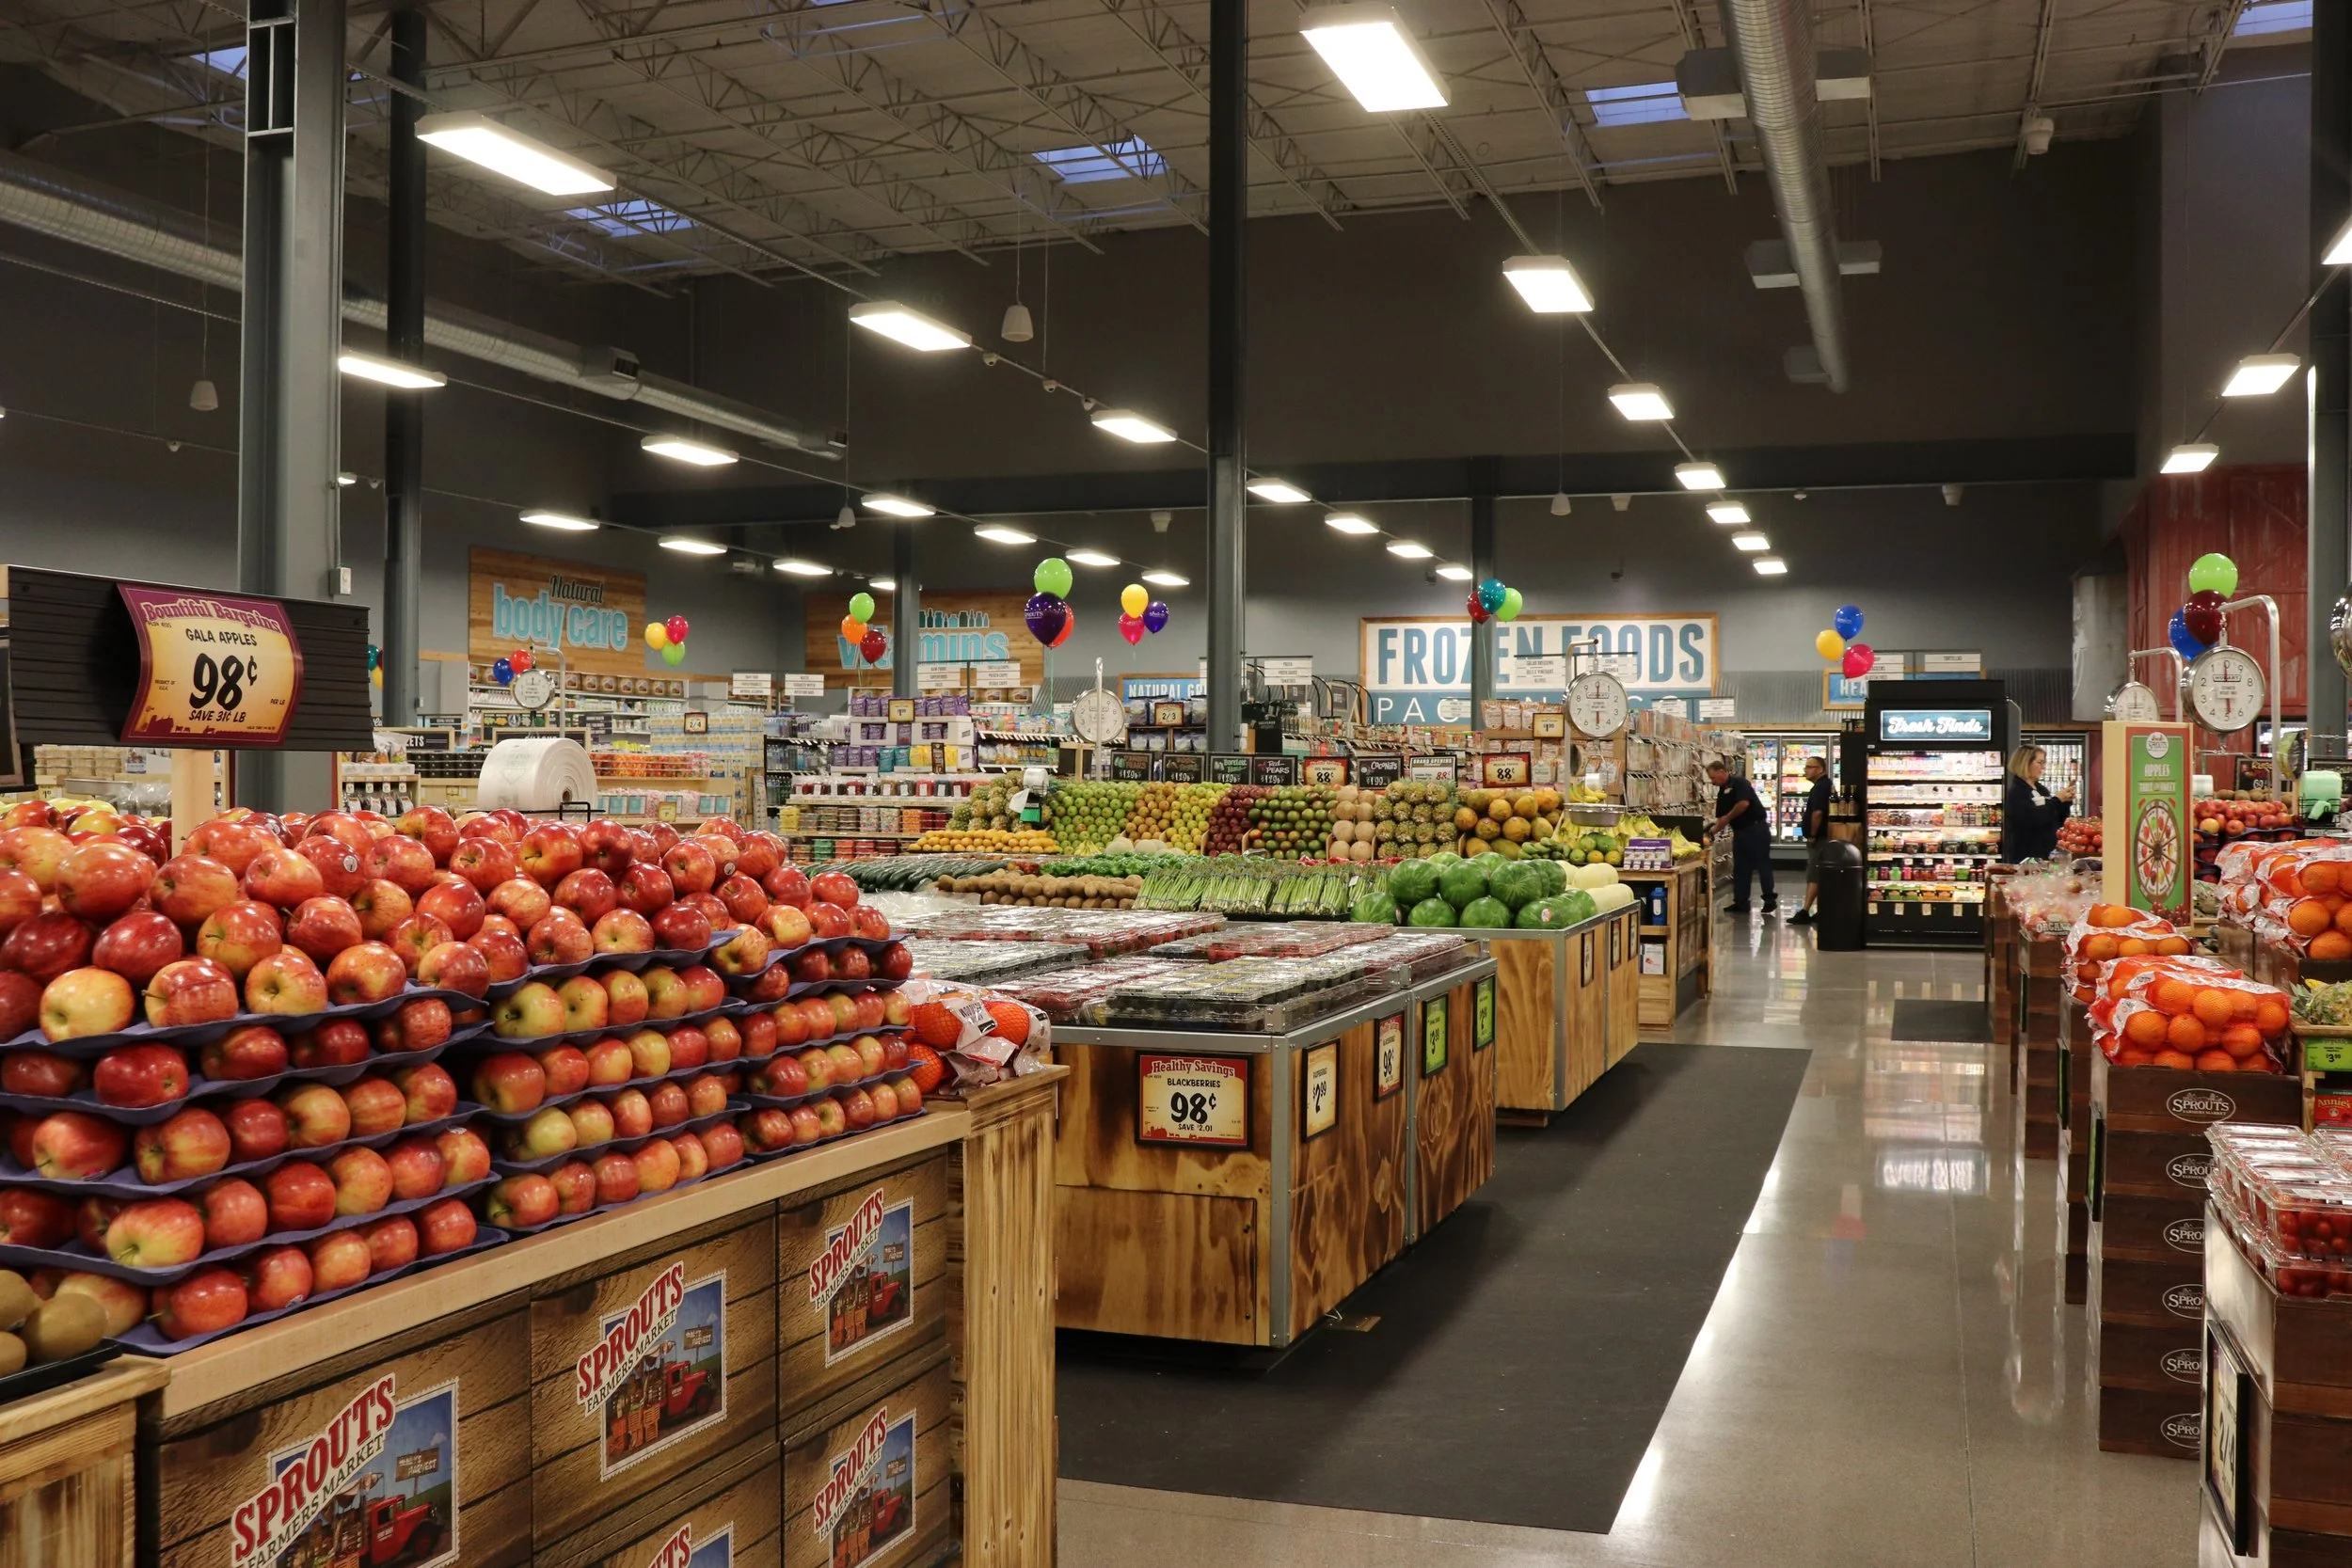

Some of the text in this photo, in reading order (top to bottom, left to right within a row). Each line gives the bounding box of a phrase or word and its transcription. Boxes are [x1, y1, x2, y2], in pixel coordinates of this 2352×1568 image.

[548, 574, 606, 604] Natural
[141, 598, 282, 634] Bountiful Bargains
[493, 583, 628, 651] body care
[185, 628, 258, 647] GALA APPLES
[1378, 626, 1543, 685] FROZEN
[1562, 624, 1704, 683] FOODS
[188, 709, 215, 722] SAVE
[233, 711, 246, 723] LB
[1887, 716, 1983, 734] Fresh Finds
[2144, 763, 2170, 777] APPLES
[1152, 1059, 1234, 1078] Healthy Savings
[1167, 1078, 1221, 1088] BLACKBERRIES
[2172, 1099, 2230, 1112] SPROUTS
[2317, 1098, 2352, 1108] Annie's
[811, 1190, 883, 1298] SPROUTS
[2169, 1228, 2204, 1242] SPRO
[816, 1228, 879, 1309] FARMERS MARKET
[579, 1264, 684, 1400] SPROUTS
[586, 1309, 676, 1413] FARMERS MARKET
[2167, 1357, 2201, 1372] SPRO
[234, 1376, 394, 1561] SPROUTS
[815, 1409, 886, 1529] SPROUTS
[246, 1433, 385, 1568] FARMERS MARKET
[819, 1447, 882, 1540] FARMERS MARKET
